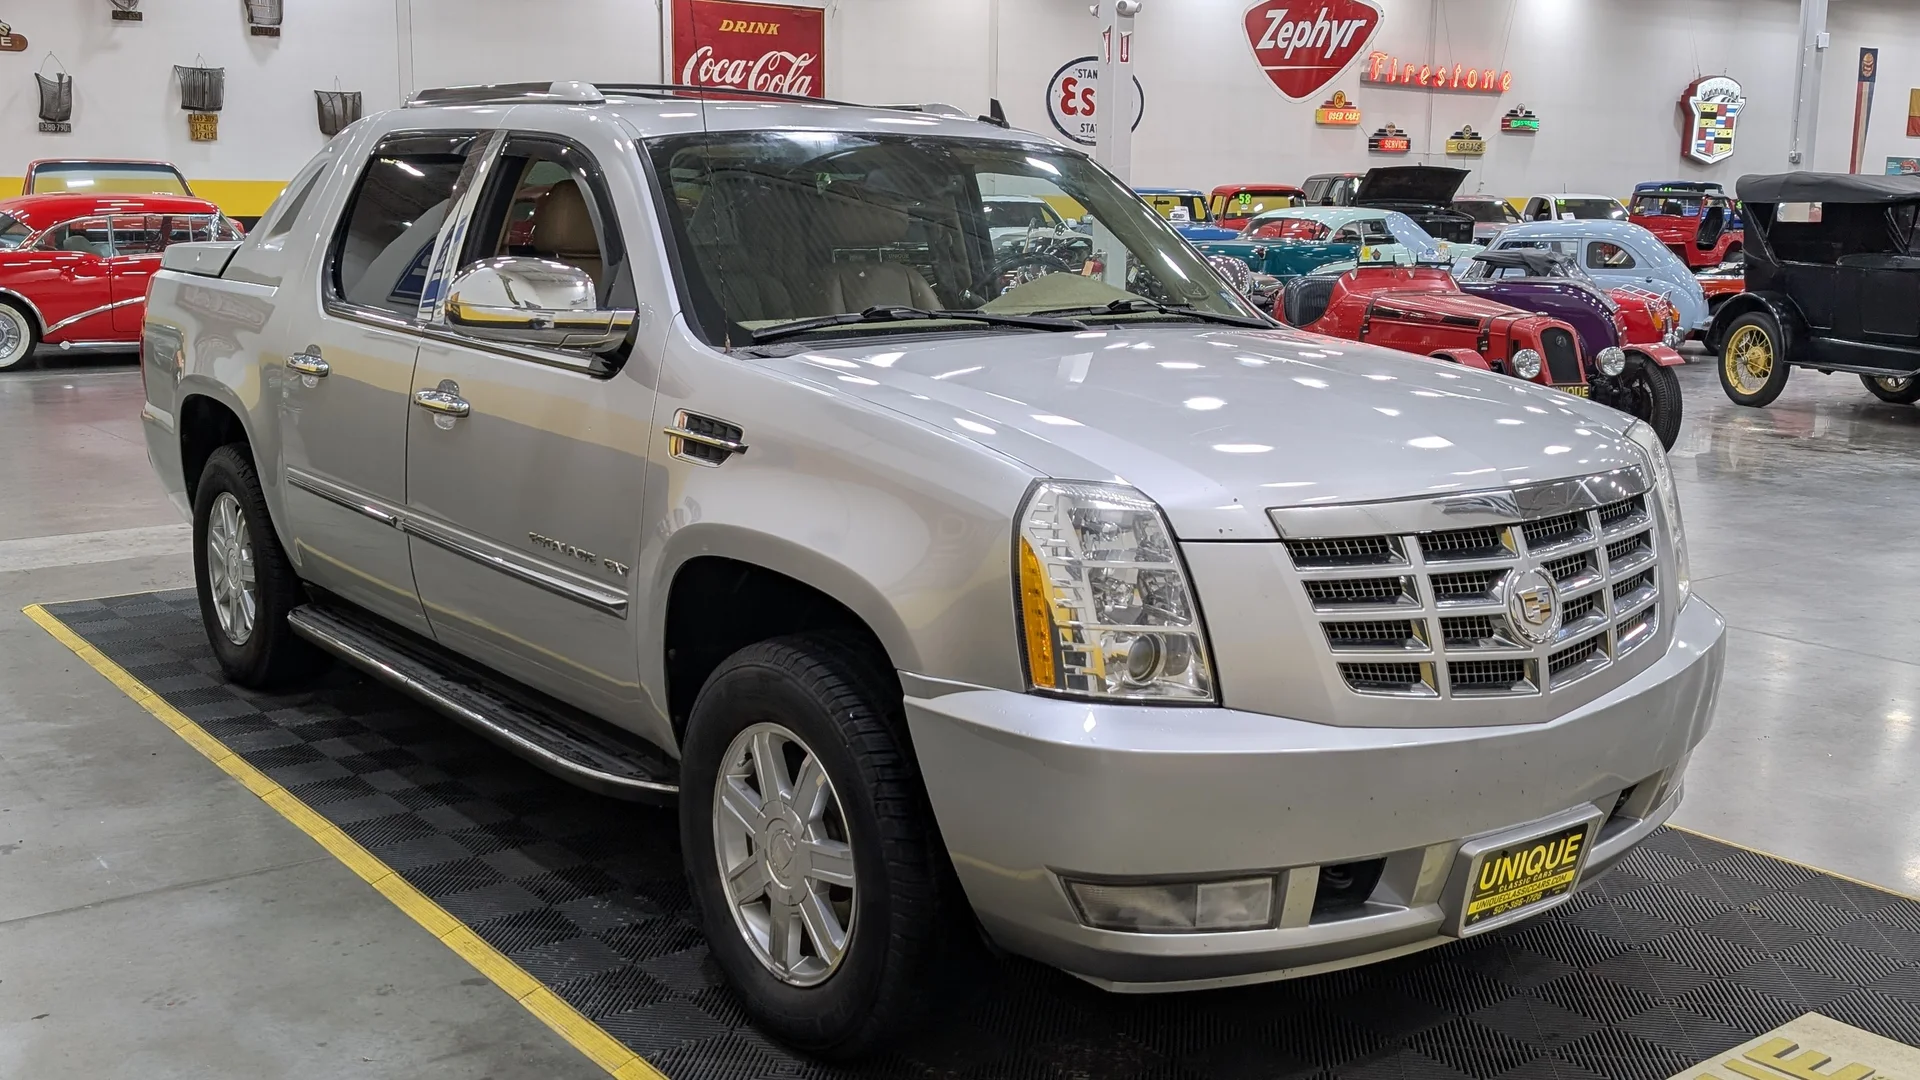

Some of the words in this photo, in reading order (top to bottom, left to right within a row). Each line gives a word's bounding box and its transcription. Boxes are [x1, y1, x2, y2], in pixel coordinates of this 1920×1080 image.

[719, 19, 780, 35] DRINK
[1256, 7, 1367, 59] Zephyr
[682, 46, 817, 97] Coca-Cola
[1369, 51, 1512, 92] Firestone
[1061, 77, 1096, 116] Es
[1328, 111, 1344, 121] USED
[1345, 111, 1360, 121] CARS
[1384, 139, 1408, 150] SERVICE
[1239, 194, 1251, 204] 58
[1480, 834, 1582, 890] UNIQUE
[1475, 874, 1568, 910] UNIQUECLASSICCARS.COM
[1499, 877, 1531, 892] CLASSIC
[1533, 869, 1553, 881] CARS
